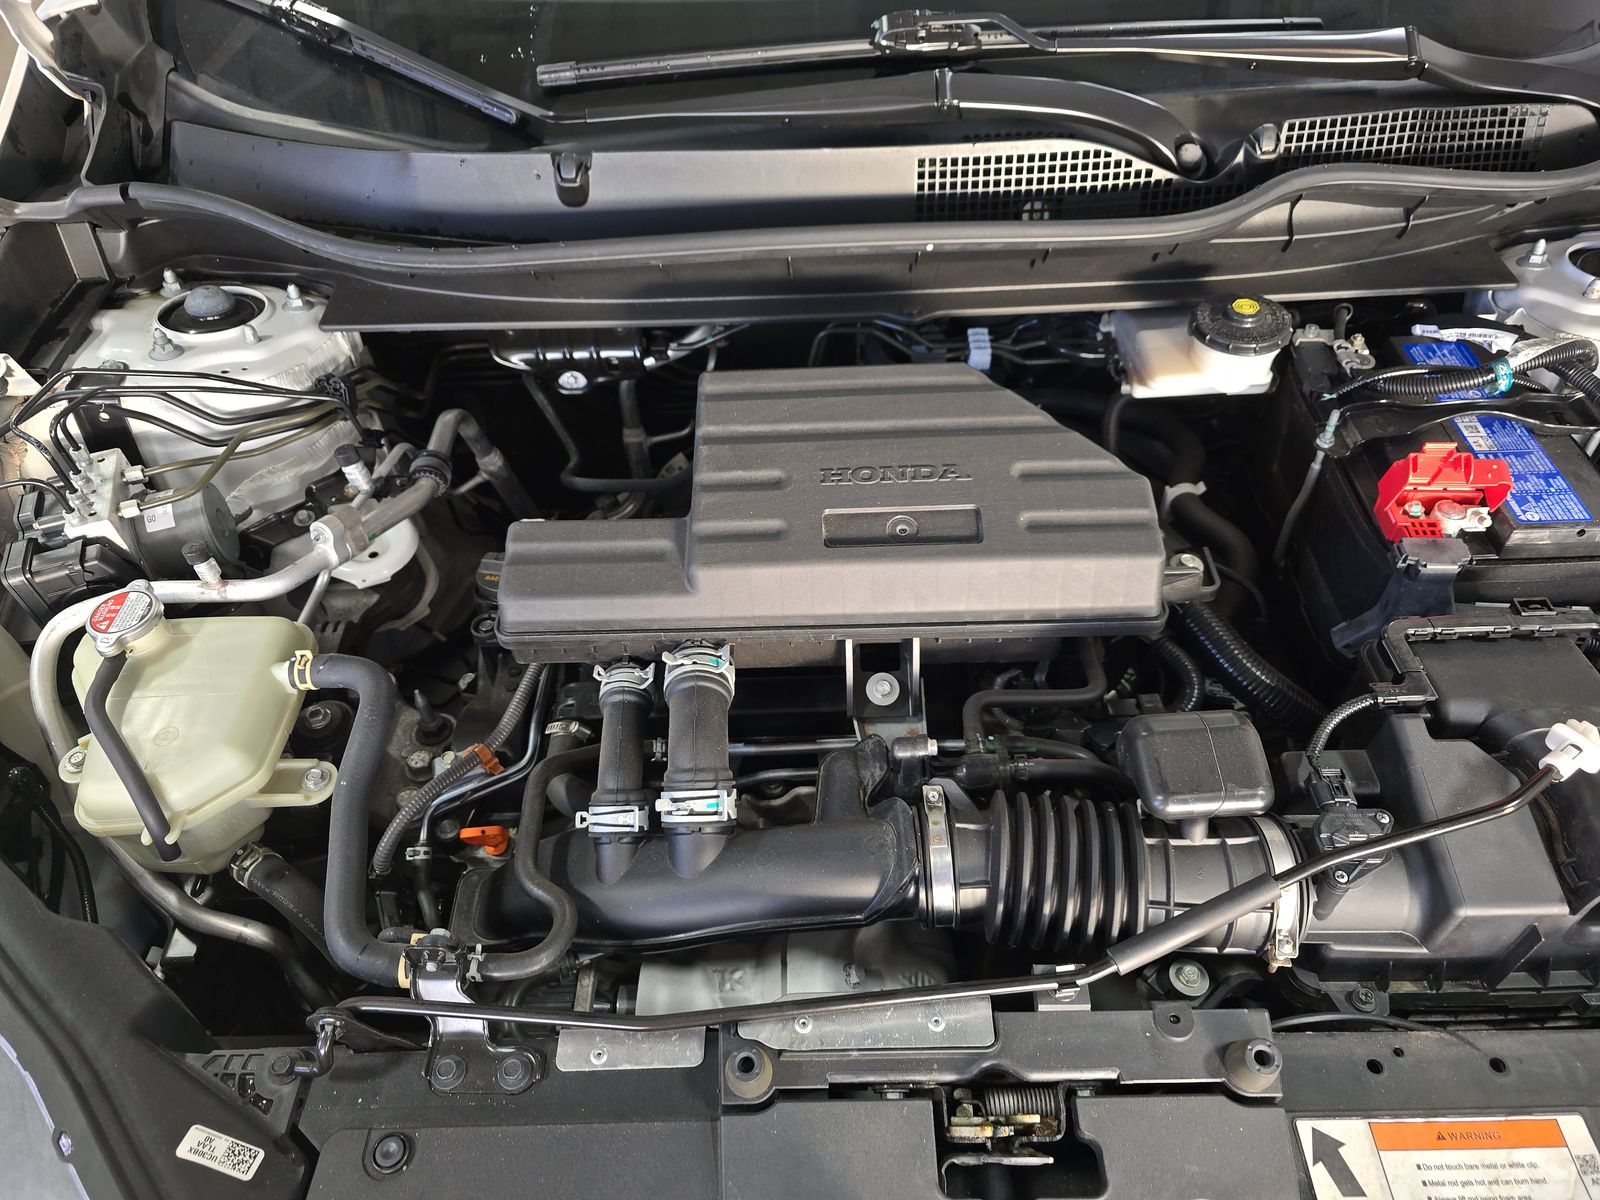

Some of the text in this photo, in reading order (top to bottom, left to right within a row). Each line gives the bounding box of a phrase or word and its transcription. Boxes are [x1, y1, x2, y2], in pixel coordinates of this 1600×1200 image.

[819, 464, 973, 486] HONDA
[1448, 1131, 1501, 1141] WARNING
[196, 1140, 216, 1153] TLAA
[1422, 1163, 1433, 1171] Do
[1433, 1163, 1445, 1171] not
[1445, 1162, 1464, 1170] touch
[1464, 1162, 1480, 1170] bare
[1480, 1162, 1499, 1170] metal
[1428, 1179, 1447, 1187] Metal
[1447, 1179, 1459, 1187] rod
[1460, 1179, 1474, 1188] gets
[1474, 1178, 1486, 1186] hot
[1513, 1178, 1530, 1186] burn
